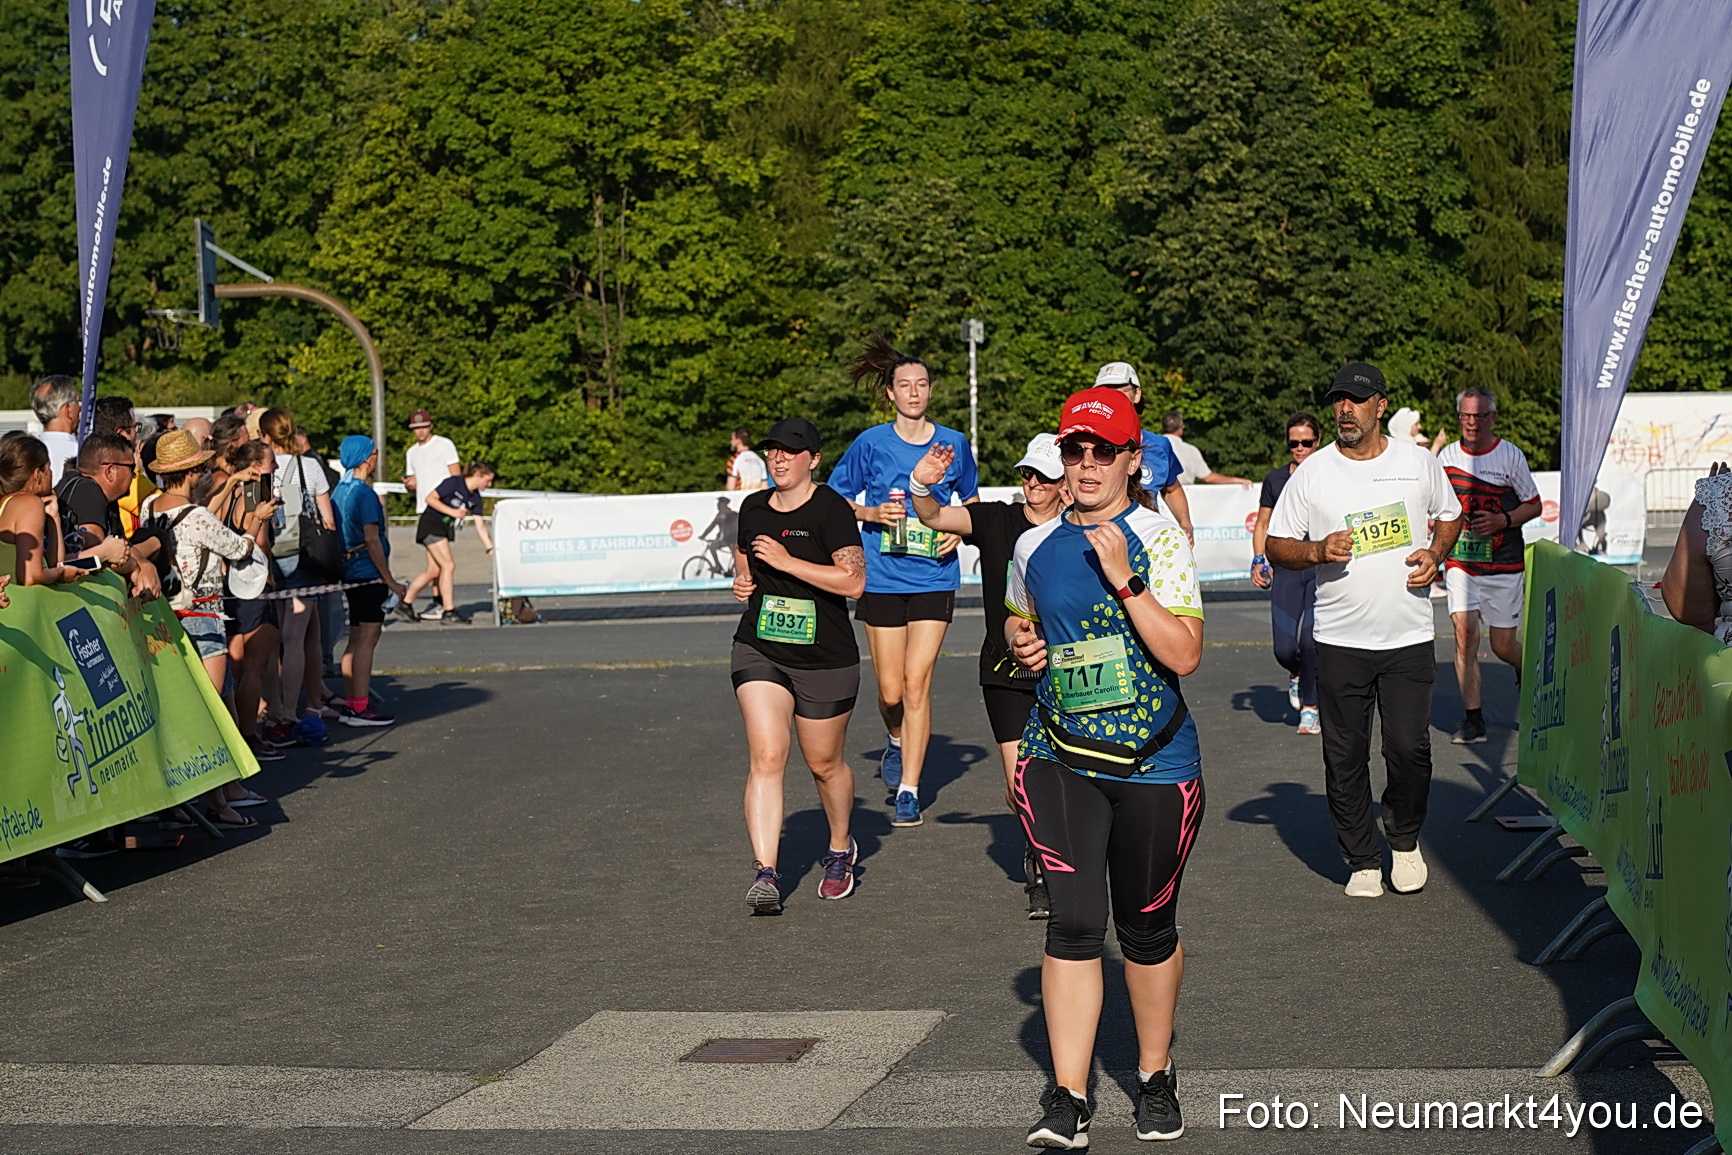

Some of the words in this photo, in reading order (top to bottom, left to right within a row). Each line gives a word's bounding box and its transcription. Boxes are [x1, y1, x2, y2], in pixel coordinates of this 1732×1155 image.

[1596, 78, 1711, 389] www.fischer-automobile.de
[1081, 401, 1103, 410] AVIA
[1089, 409, 1111, 419] racing
[518, 518, 553, 531] NOW
[1195, 526, 1247, 540] RRÄDER
[1360, 519, 1401, 541] 1975
[1401, 519, 1409, 540] 2022
[522, 540, 574, 553] E-BIKES
[578, 539, 589, 551] &
[908, 530, 924, 543] 51
[1353, 531, 1362, 552] WALK
[1462, 541, 1482, 551] 147
[768, 611, 807, 630] 1937
[76, 637, 101, 660] Fischer
[1063, 663, 1104, 690] 717
[1115, 662, 1129, 695] 2022
[1054, 677, 1063, 700] RUN
[1094, 685, 1119, 695] Carolin
[99, 749, 138, 785] neumarkt
[0, 799, 44, 851] pfalz.de
